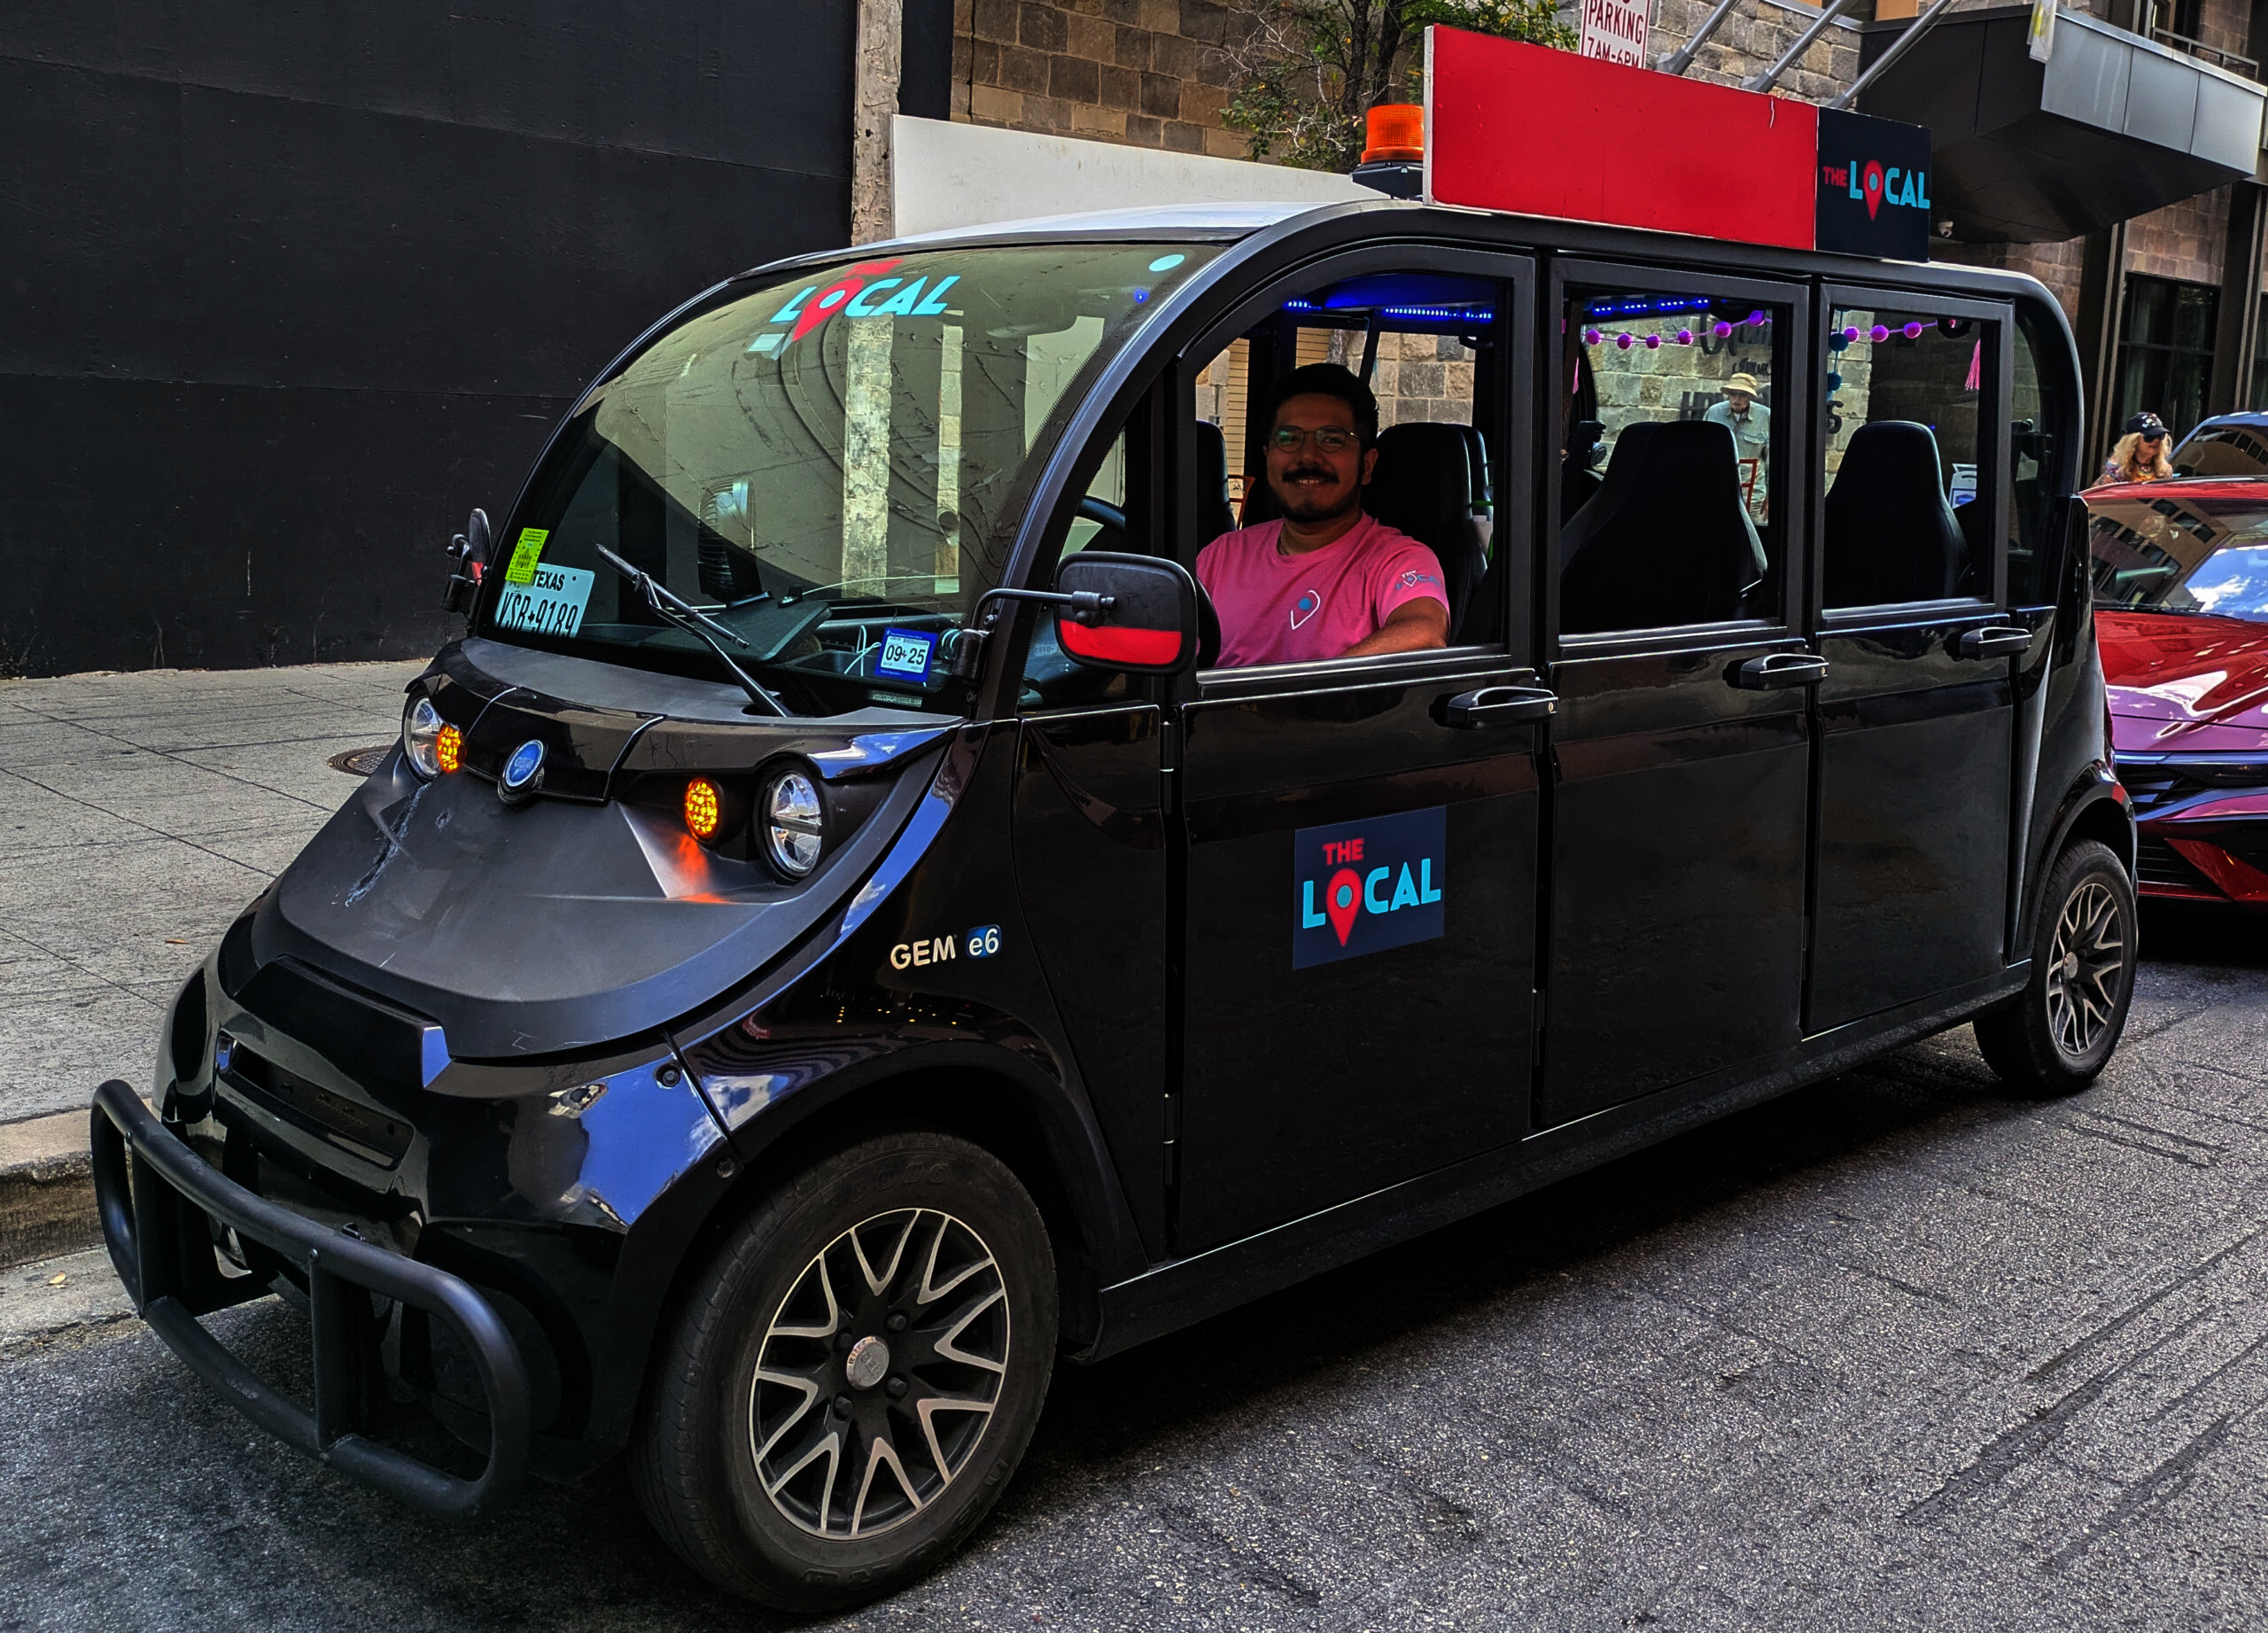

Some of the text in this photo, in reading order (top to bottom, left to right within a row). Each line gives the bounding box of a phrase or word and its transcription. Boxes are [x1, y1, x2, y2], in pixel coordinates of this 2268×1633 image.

[1588, 0, 1643, 44] PARKING
[1823, 166, 1847, 187] THE
[532, 570, 565, 591] TEXAS
[886, 644, 927, 665] 09 25
[1323, 837, 1364, 866] THE
[890, 928, 999, 970] GEM e6
